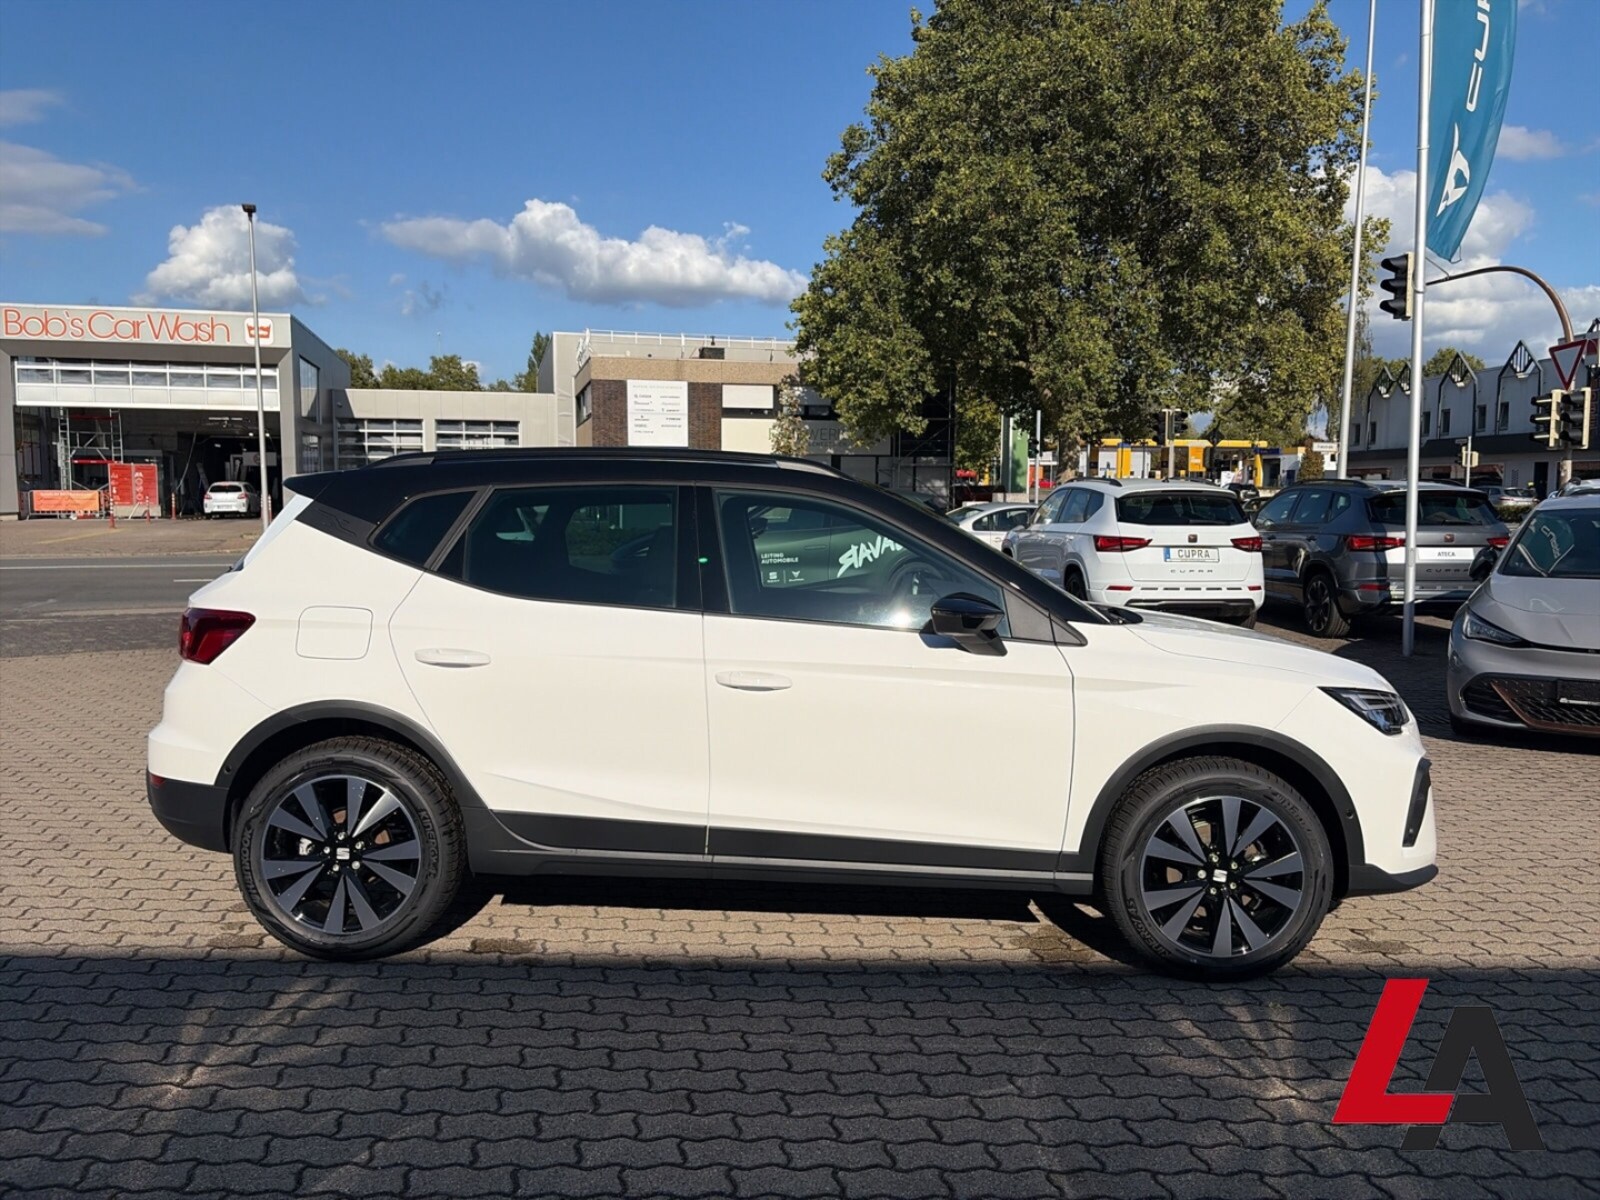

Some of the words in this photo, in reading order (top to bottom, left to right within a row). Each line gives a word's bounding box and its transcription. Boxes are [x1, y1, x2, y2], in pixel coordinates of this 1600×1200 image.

[1466, 0, 1490, 112] CU
[3, 308, 85, 338] Bob's
[88, 310, 146, 340] Car
[146, 313, 231, 343] Wash
[1177, 549, 1211, 558] CUPRA
